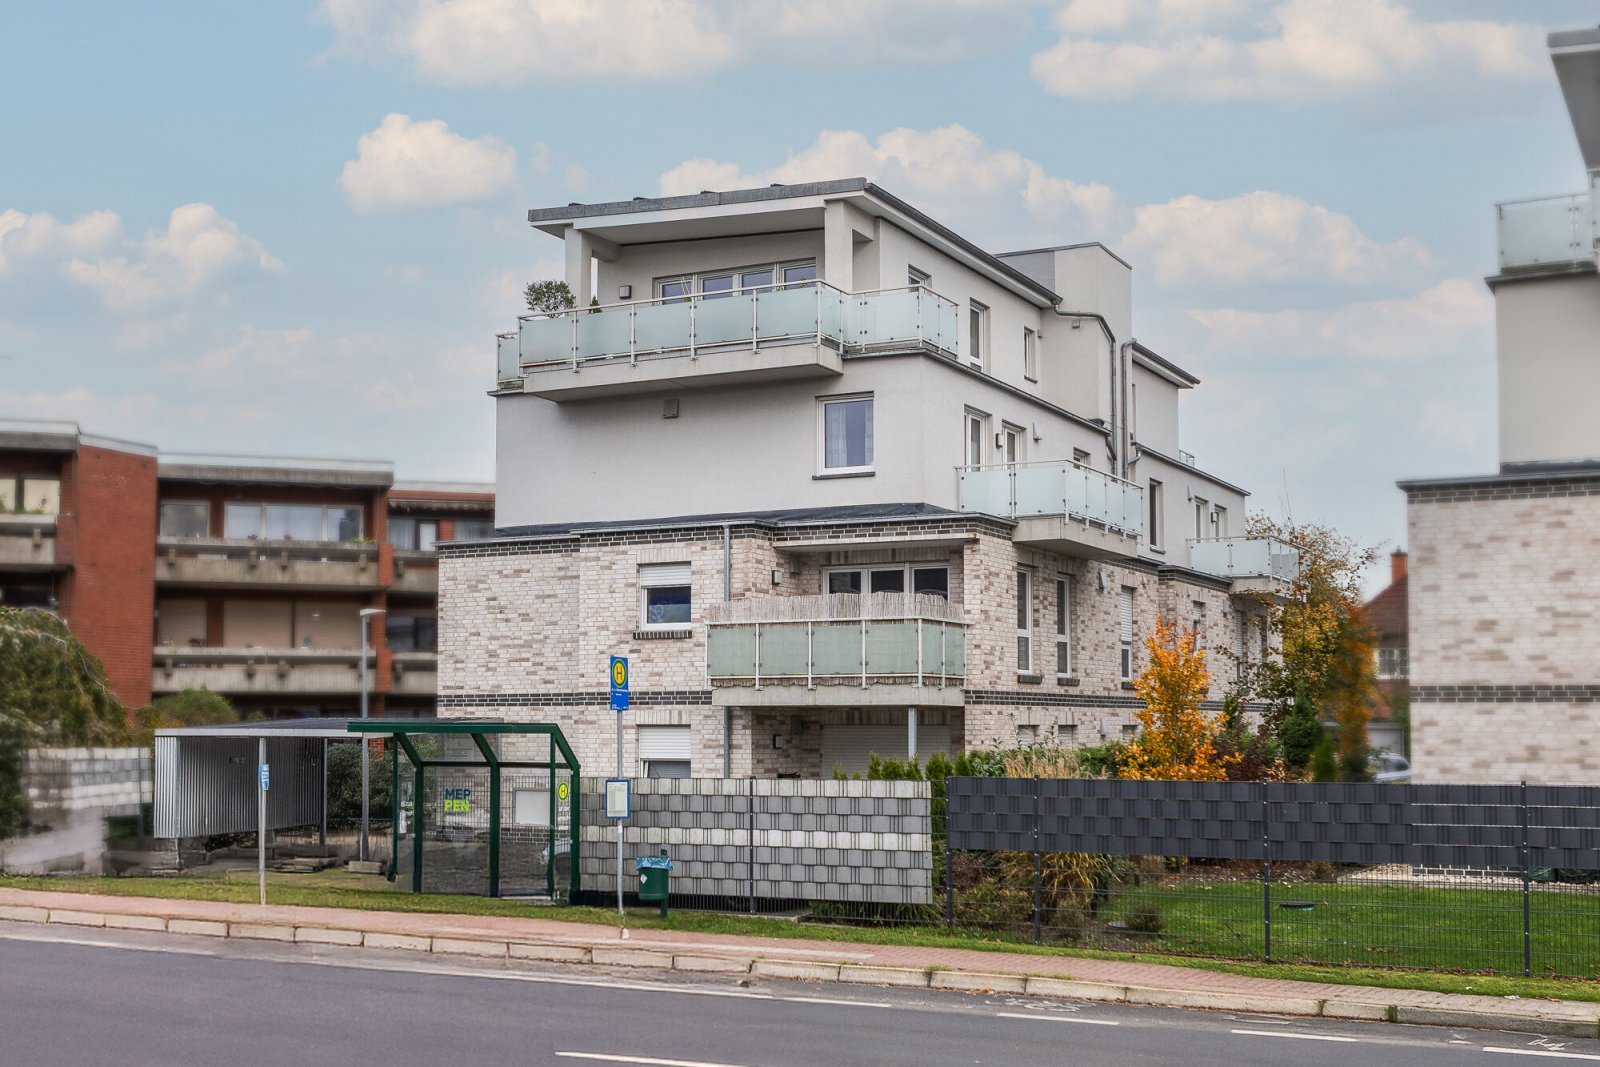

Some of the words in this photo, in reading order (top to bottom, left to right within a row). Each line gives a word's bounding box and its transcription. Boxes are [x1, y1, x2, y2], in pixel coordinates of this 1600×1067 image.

[616, 665, 623, 681] H
[445, 788, 471, 799] MEP
[445, 800, 470, 812] PEN
